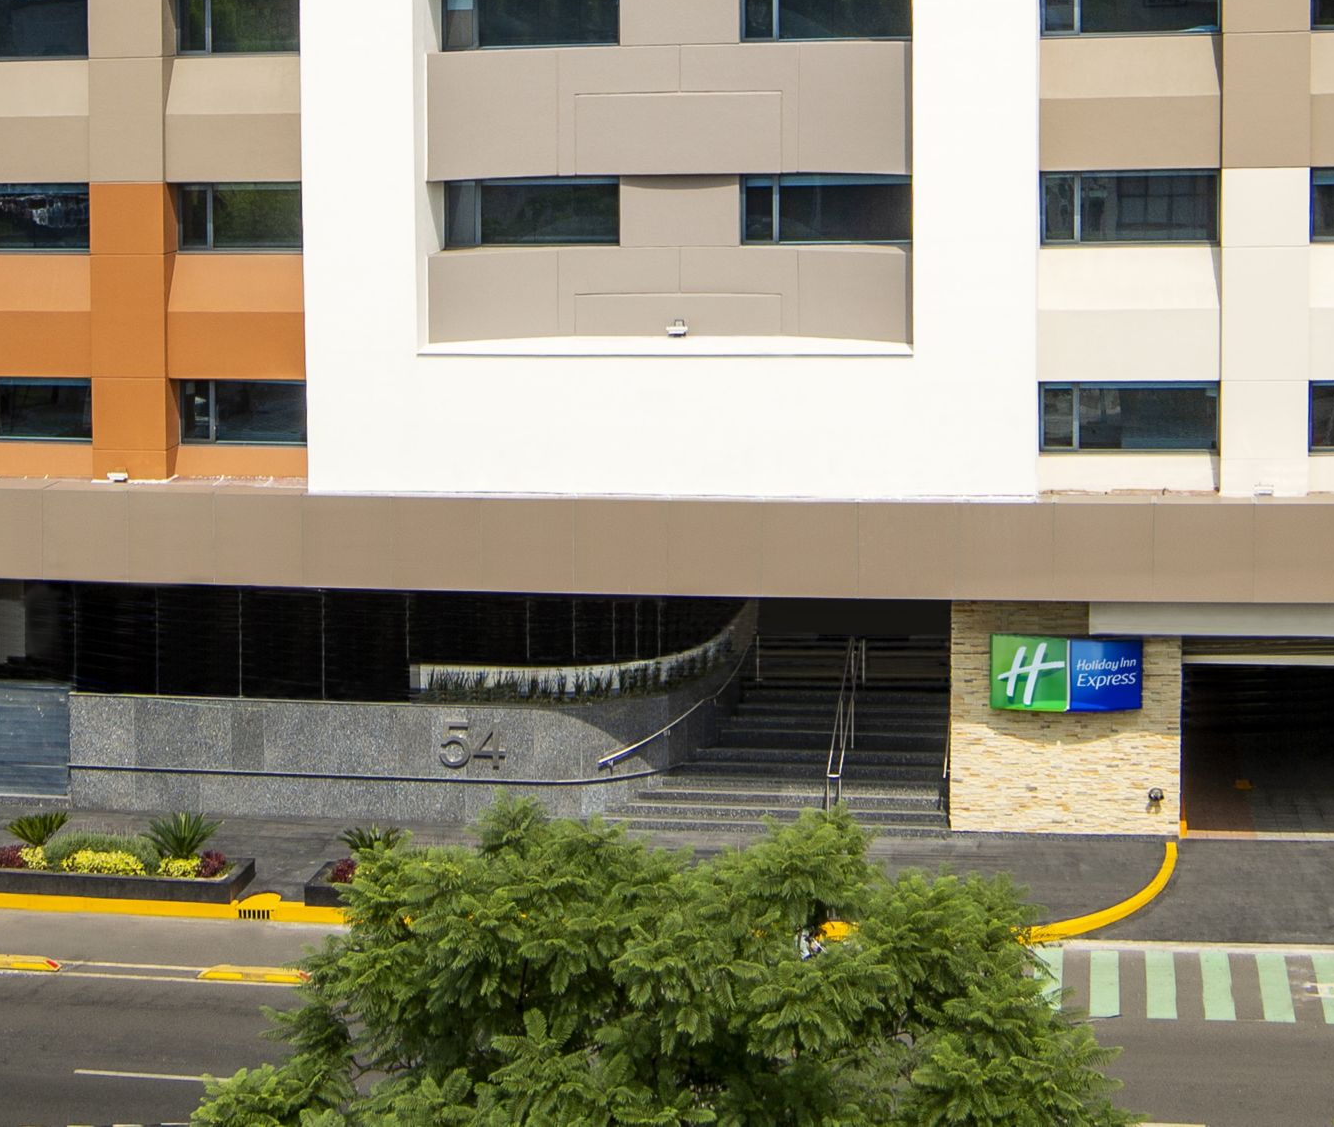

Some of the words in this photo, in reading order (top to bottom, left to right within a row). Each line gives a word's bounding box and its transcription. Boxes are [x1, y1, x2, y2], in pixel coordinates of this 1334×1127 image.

[1077, 658, 1119, 671] Holiday
[1120, 657, 1137, 668] Inn
[1077, 672, 1137, 690] Express
[439, 721, 507, 770] 54
